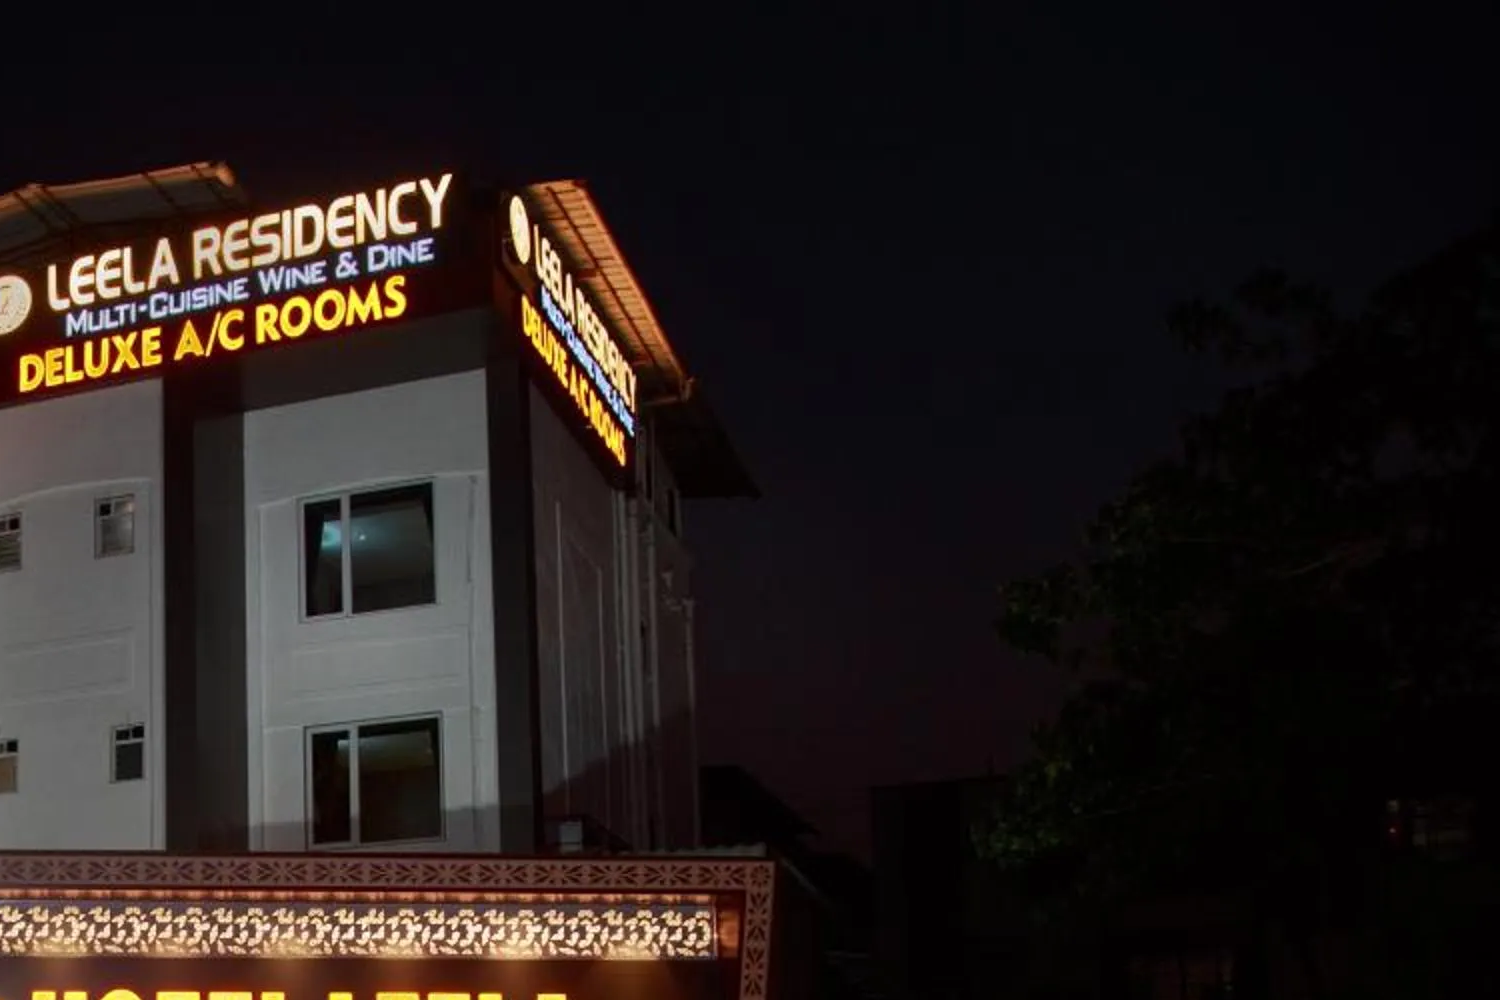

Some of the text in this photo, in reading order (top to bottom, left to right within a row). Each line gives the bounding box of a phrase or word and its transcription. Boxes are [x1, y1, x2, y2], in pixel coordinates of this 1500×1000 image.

[47, 173, 453, 312] LEELA RESIDENCY
[258, 260, 327, 295] WINE
[335, 251, 360, 279] &
[367, 237, 435, 273] DINE
[19, 275, 408, 392] DELUXE A/C ROOMS
